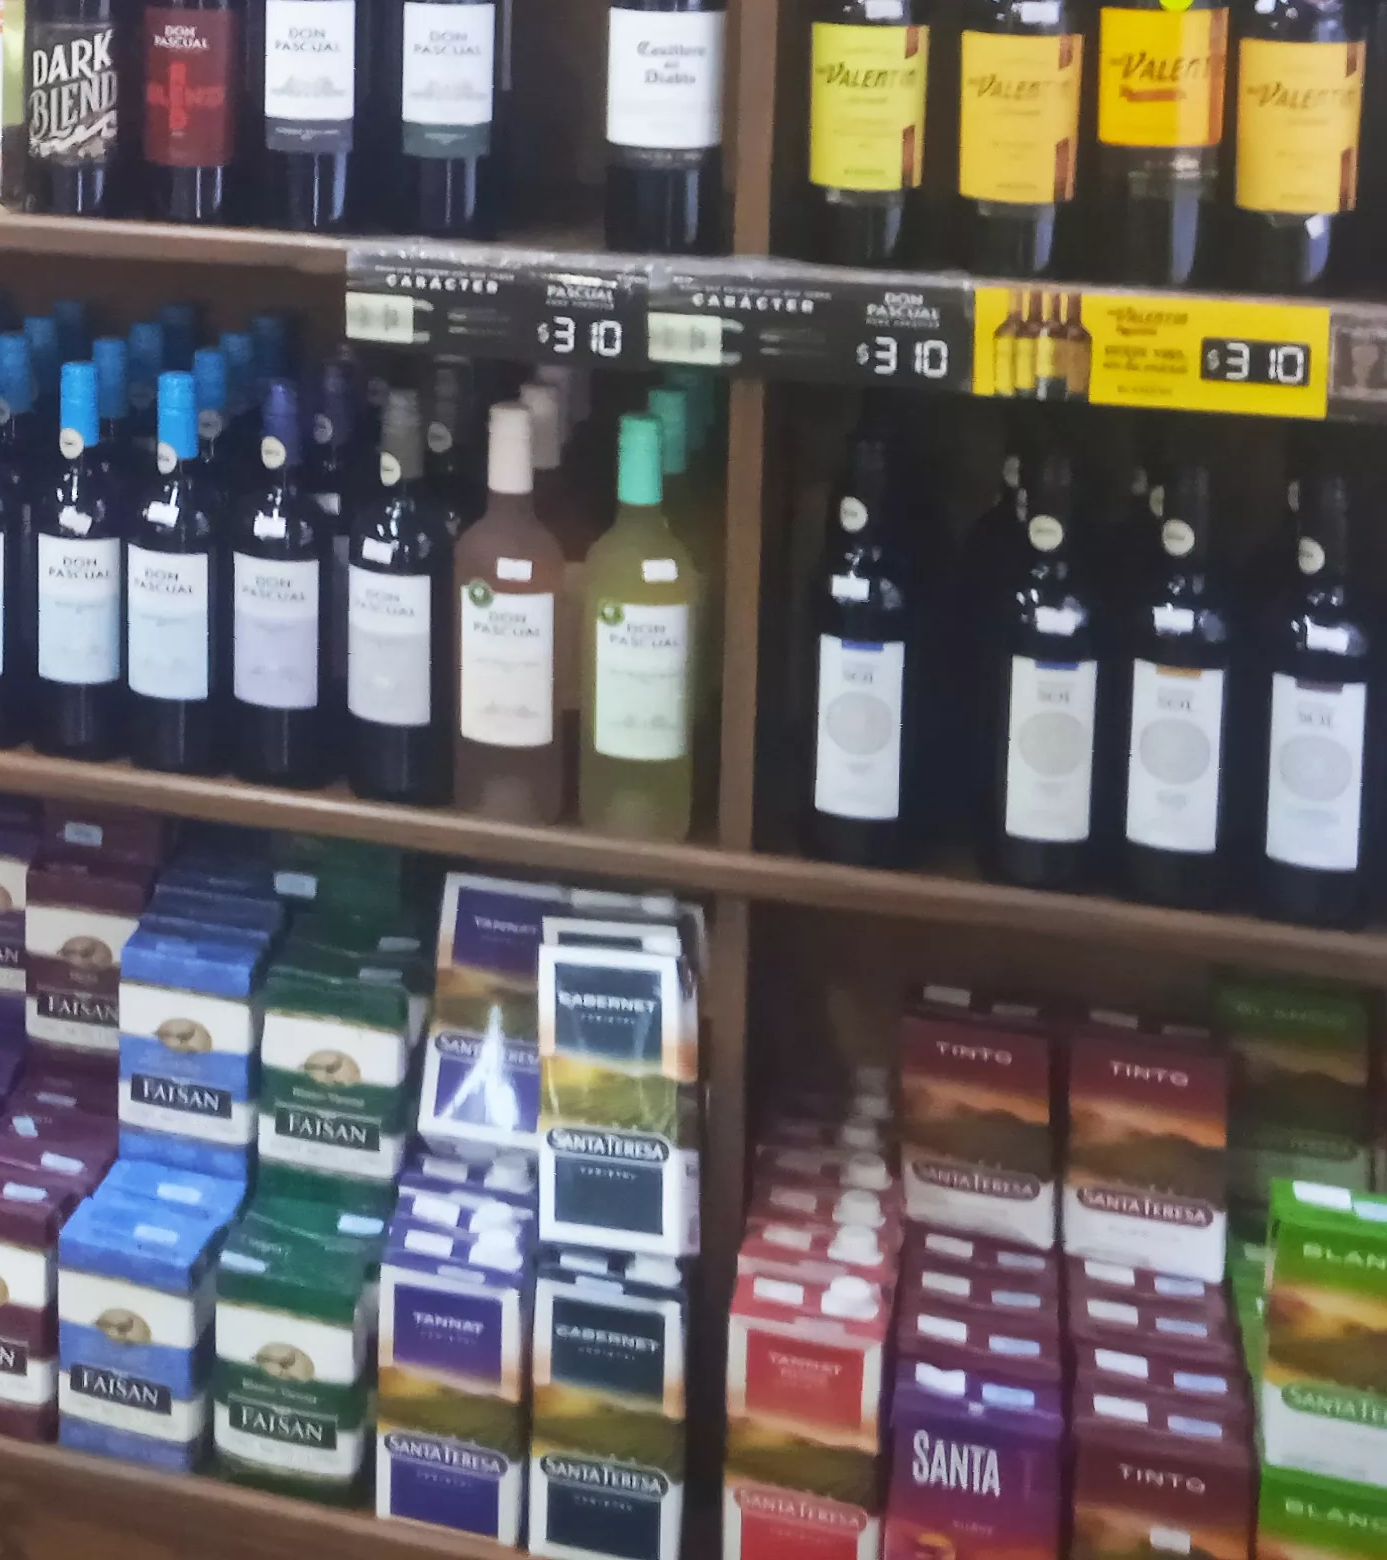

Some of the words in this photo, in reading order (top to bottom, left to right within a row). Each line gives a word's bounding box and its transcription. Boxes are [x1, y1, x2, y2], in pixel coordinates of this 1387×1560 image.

[32, 28, 116, 89] DARK
[28, 70, 118, 142] BLEND
[913, 1429, 1002, 1499] SANTA
[1118, 1462, 1206, 1494] TINTO
